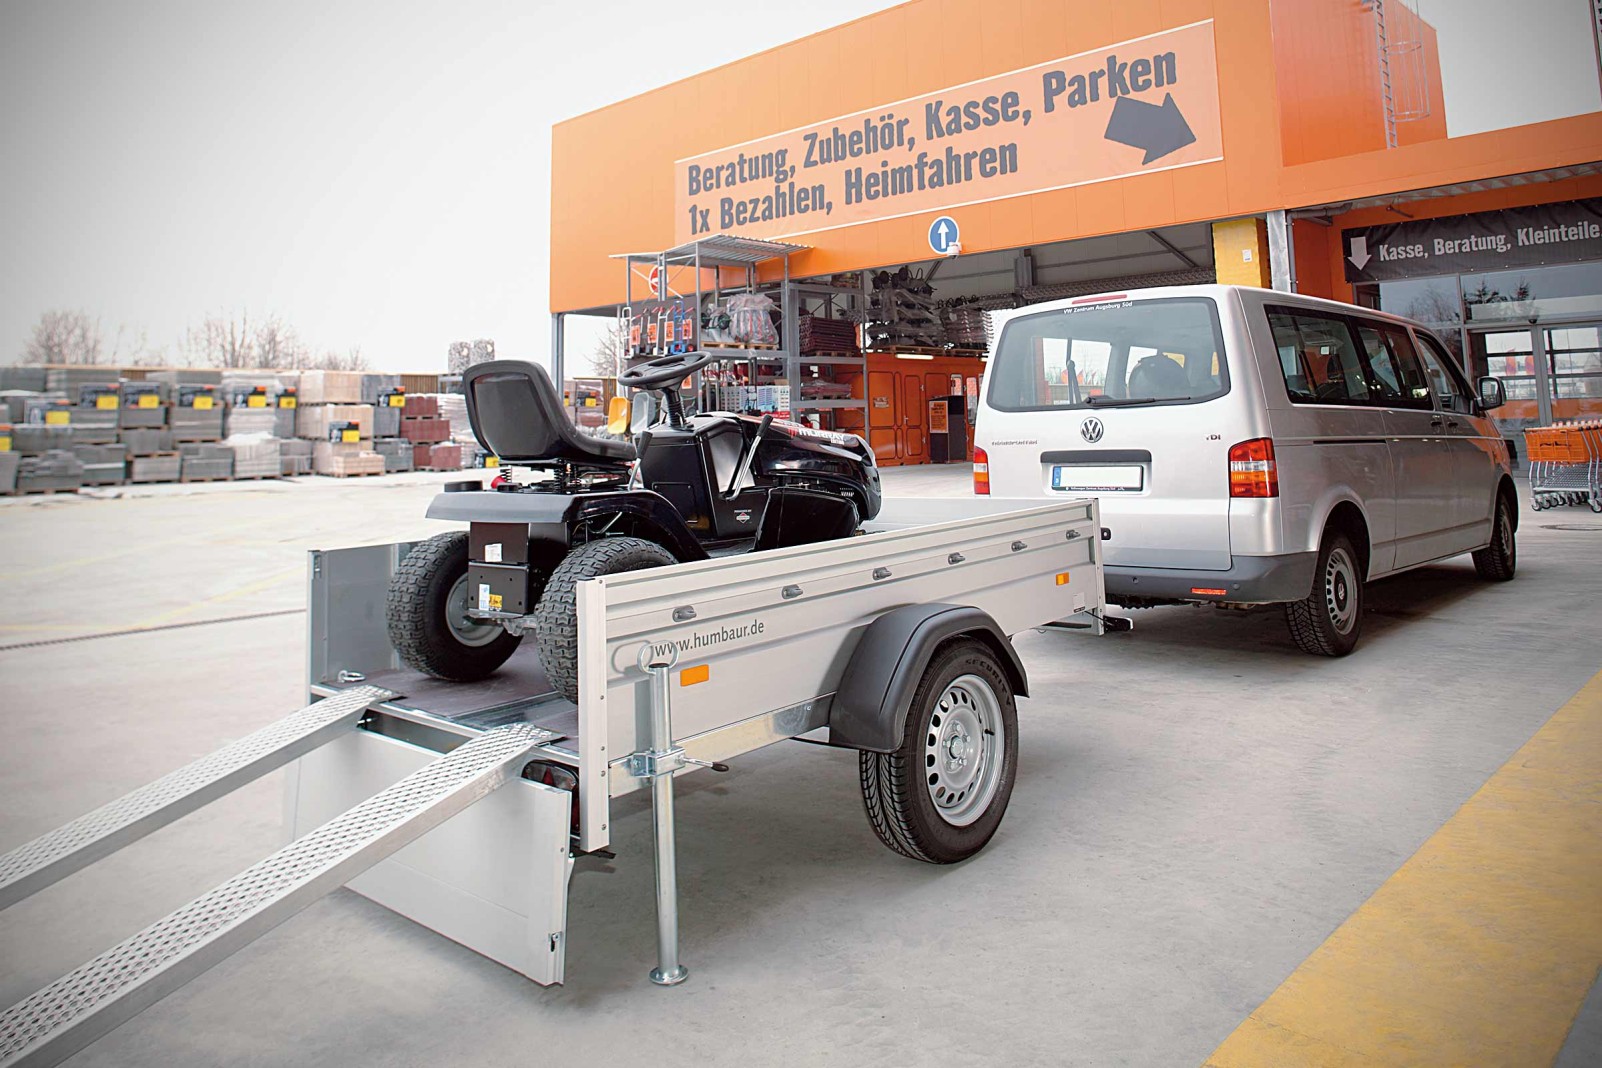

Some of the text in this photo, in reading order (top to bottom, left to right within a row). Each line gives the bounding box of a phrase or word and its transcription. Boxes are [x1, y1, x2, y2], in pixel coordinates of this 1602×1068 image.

[689, 51, 1177, 196] Beratung, Zubehör, Kasse, Parken
[688, 142, 1018, 235] 1x Bezahlen, Heimfahren
[1379, 244, 1429, 262] Kasse,
[1433, 235, 1512, 256] Beratung,
[1073, 306, 1095, 314] Zentrum
[1095, 303, 1121, 311] Augsburg
[798, 428, 844, 440] MURRAY
[654, 618, 765, 658] www.humbaur.de
